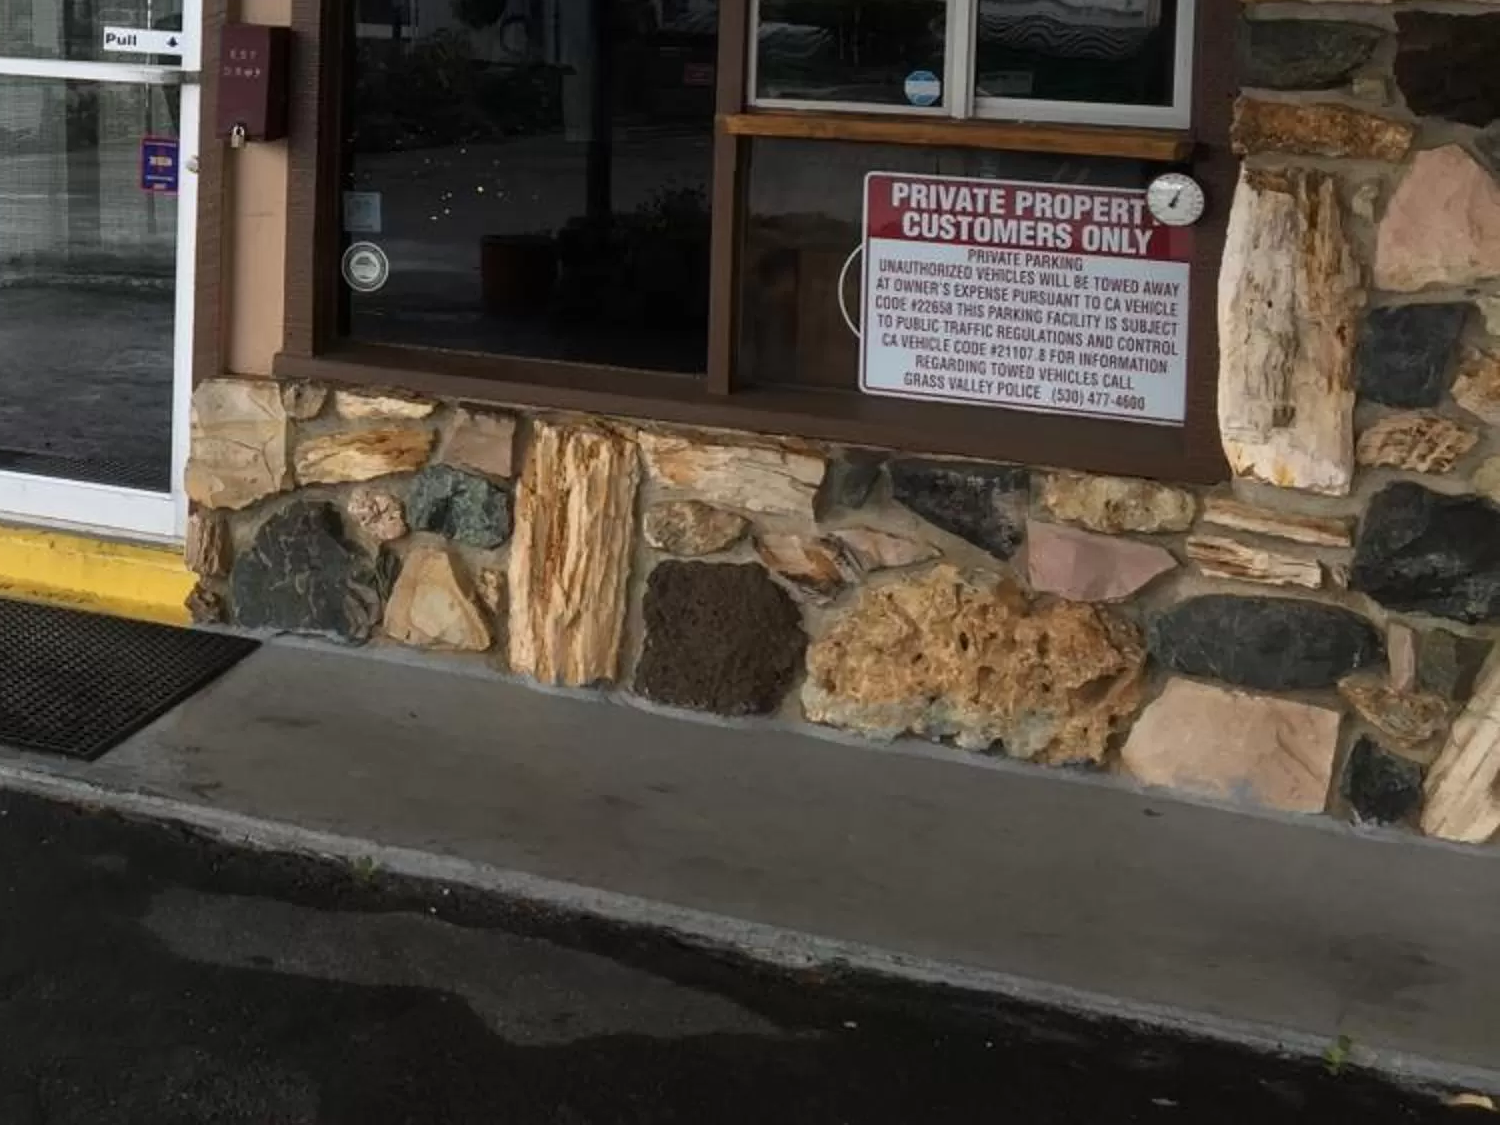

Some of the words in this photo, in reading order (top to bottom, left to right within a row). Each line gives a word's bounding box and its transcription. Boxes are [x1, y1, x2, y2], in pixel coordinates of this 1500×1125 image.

[105, 33, 137, 46] Pull
[891, 182, 1005, 215] PRIVATE
[1015, 192, 1162, 226] PROPERT
[902, 210, 1073, 249] CUSTOMERS
[1082, 225, 1153, 256] ONLY
[879, 258, 972, 280] UNAUTHORIZED
[976, 267, 1035, 285] VEHICLES
[1039, 274, 1070, 288] WILL
[1074, 276, 1089, 289] BE
[1094, 277, 1139, 294] TOWED
[1143, 281, 1180, 297] AWAY
[967, 248, 1021, 265] PRIVATE
[1025, 254, 1083, 272] PARKING
[875, 295, 907, 312] CODE
[957, 303, 985, 318] THIS
[988, 306, 1043, 324] PARKING
[1047, 311, 1102, 329] FACILITY
[1105, 316, 1117, 330] IS
[1121, 318, 1178, 337] SUBJECT
[876, 277, 890, 291] AT
[894, 279, 951, 296] OWNER'S
[954, 284, 1009, 302] EXPENSE
[1012, 290, 1079, 308] PURSUANT
[1084, 294, 1101, 307] TO
[1104, 297, 1121, 311] CA
[1125, 299, 1178, 317] VEHICLE
[877, 314, 893, 328] TO
[896, 316, 940, 333] PUBLIC
[944, 321, 993, 338] TRAFFIC
[997, 326, 1083, 347] REGULATIONS
[1087, 333, 1113, 350] AND
[1117, 337, 1178, 356] CONTROL
[882, 332, 898, 347] CA
[901, 335, 951, 352] VEHICLE
[954, 340, 987, 356] CODE
[1050, 349, 1075, 364] FOR
[1079, 352, 1168, 374] INFORMATION
[903, 372, 945, 389] GRASS
[948, 376, 994, 395] VALLEY
[997, 382, 1041, 400] POLICE
[1051, 386, 1084, 406] (530)
[915, 355, 987, 376] REGARDING
[990, 362, 1035, 380] TOWED
[1039, 367, 1098, 386] VEHICLES
[1102, 376, 1134, 390] CALL
